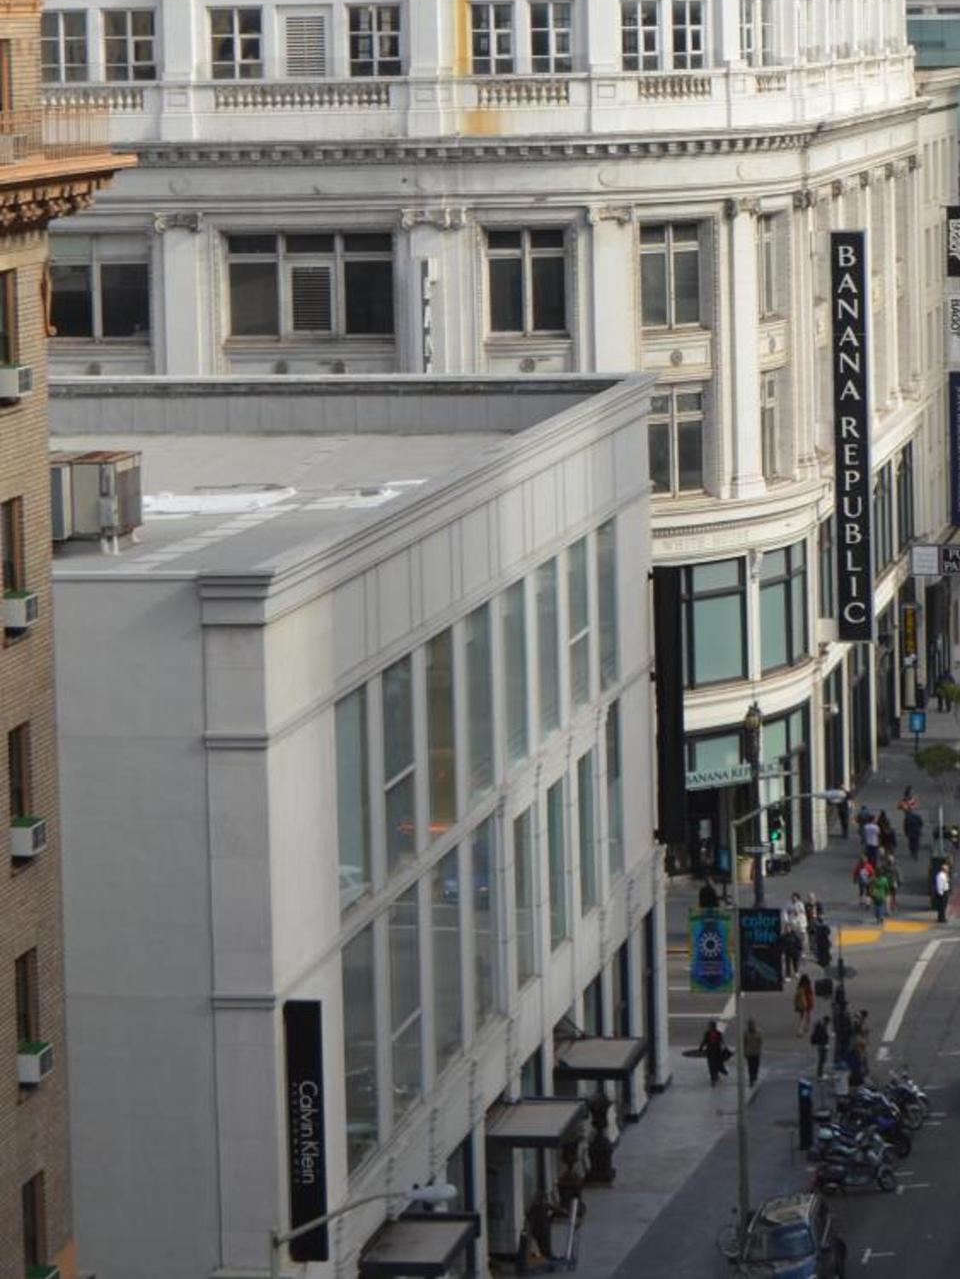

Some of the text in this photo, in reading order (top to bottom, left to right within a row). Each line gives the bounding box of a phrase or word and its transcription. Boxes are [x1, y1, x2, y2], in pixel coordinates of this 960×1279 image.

[837, 244, 867, 624] BANANA REPUBLIC
[742, 913, 778, 929] color
[300, 1082, 319, 1184] Calvin Klein
